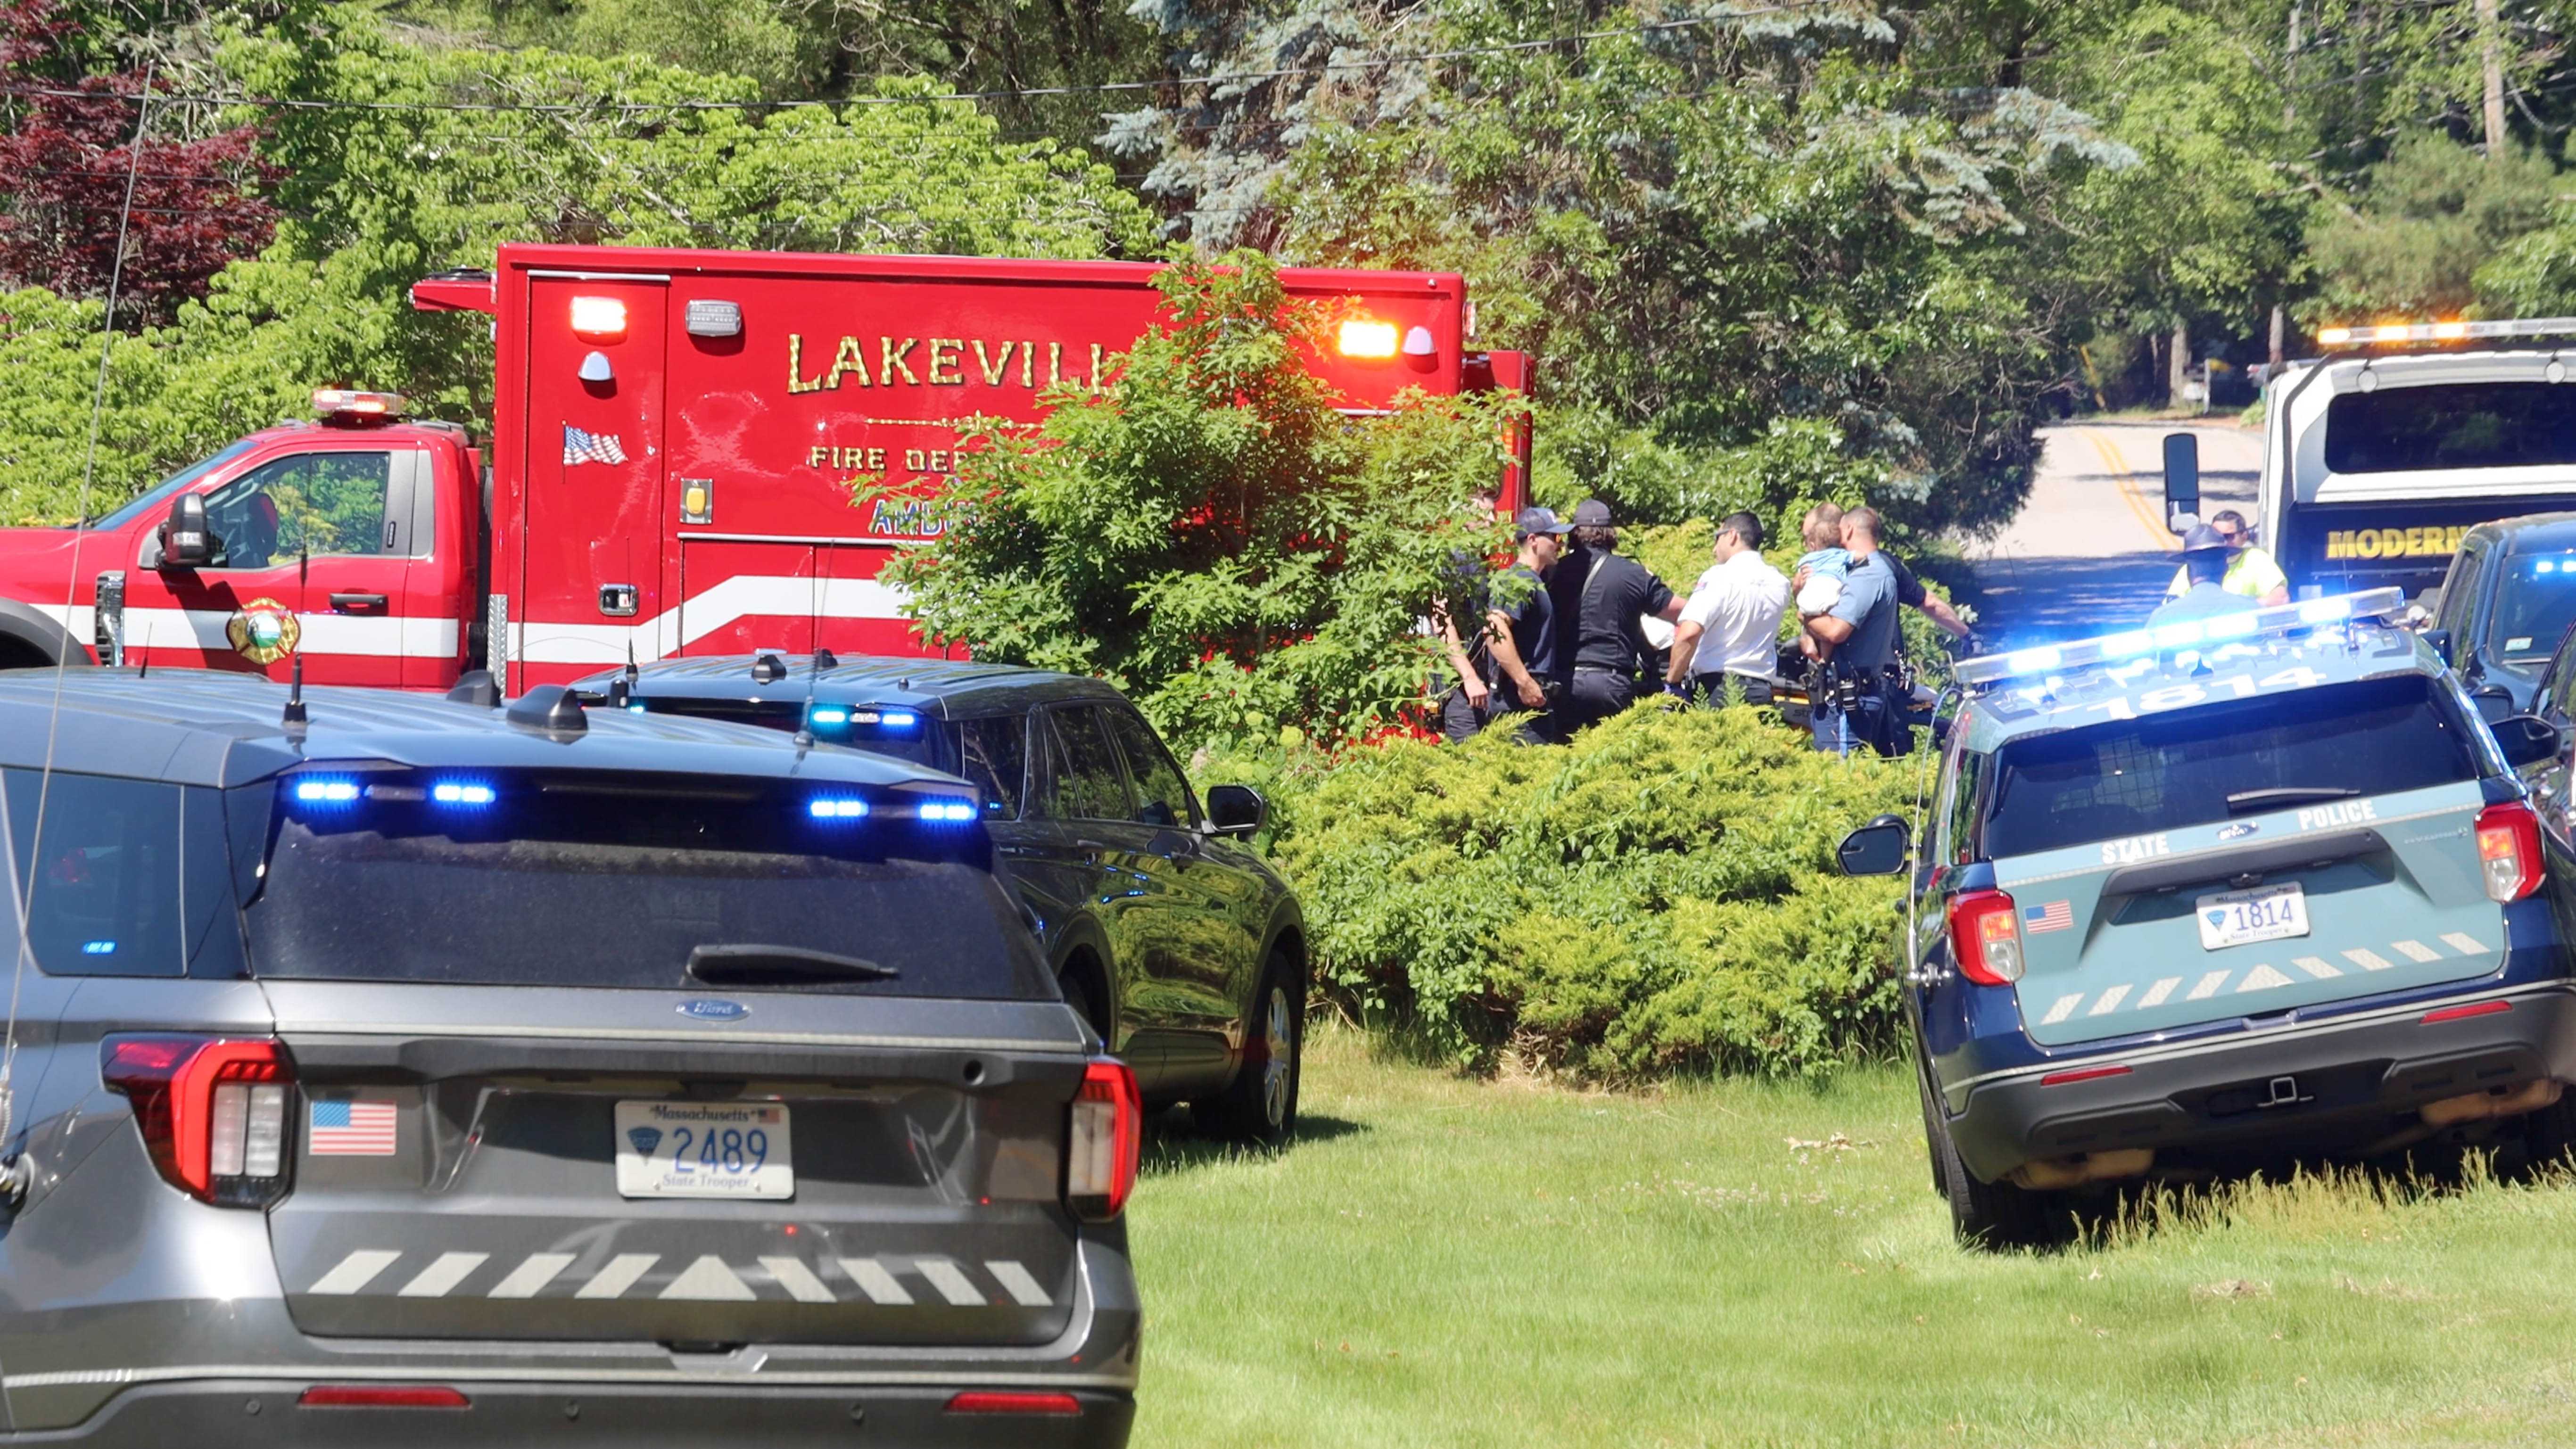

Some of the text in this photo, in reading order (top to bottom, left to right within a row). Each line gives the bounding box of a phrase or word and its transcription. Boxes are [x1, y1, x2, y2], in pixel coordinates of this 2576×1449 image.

[787, 333, 1129, 395] LAKEVILL
[810, 446, 887, 470] FIRE
[2087, 666, 2328, 720] 1814
[2101, 799, 2377, 864] STATE POLICE
[2235, 898, 2294, 931] 1814
[653, 1105, 749, 1122] Massachusetts
[673, 1127, 768, 1174] 2489
[662, 1175, 749, 1189] State Trooper
